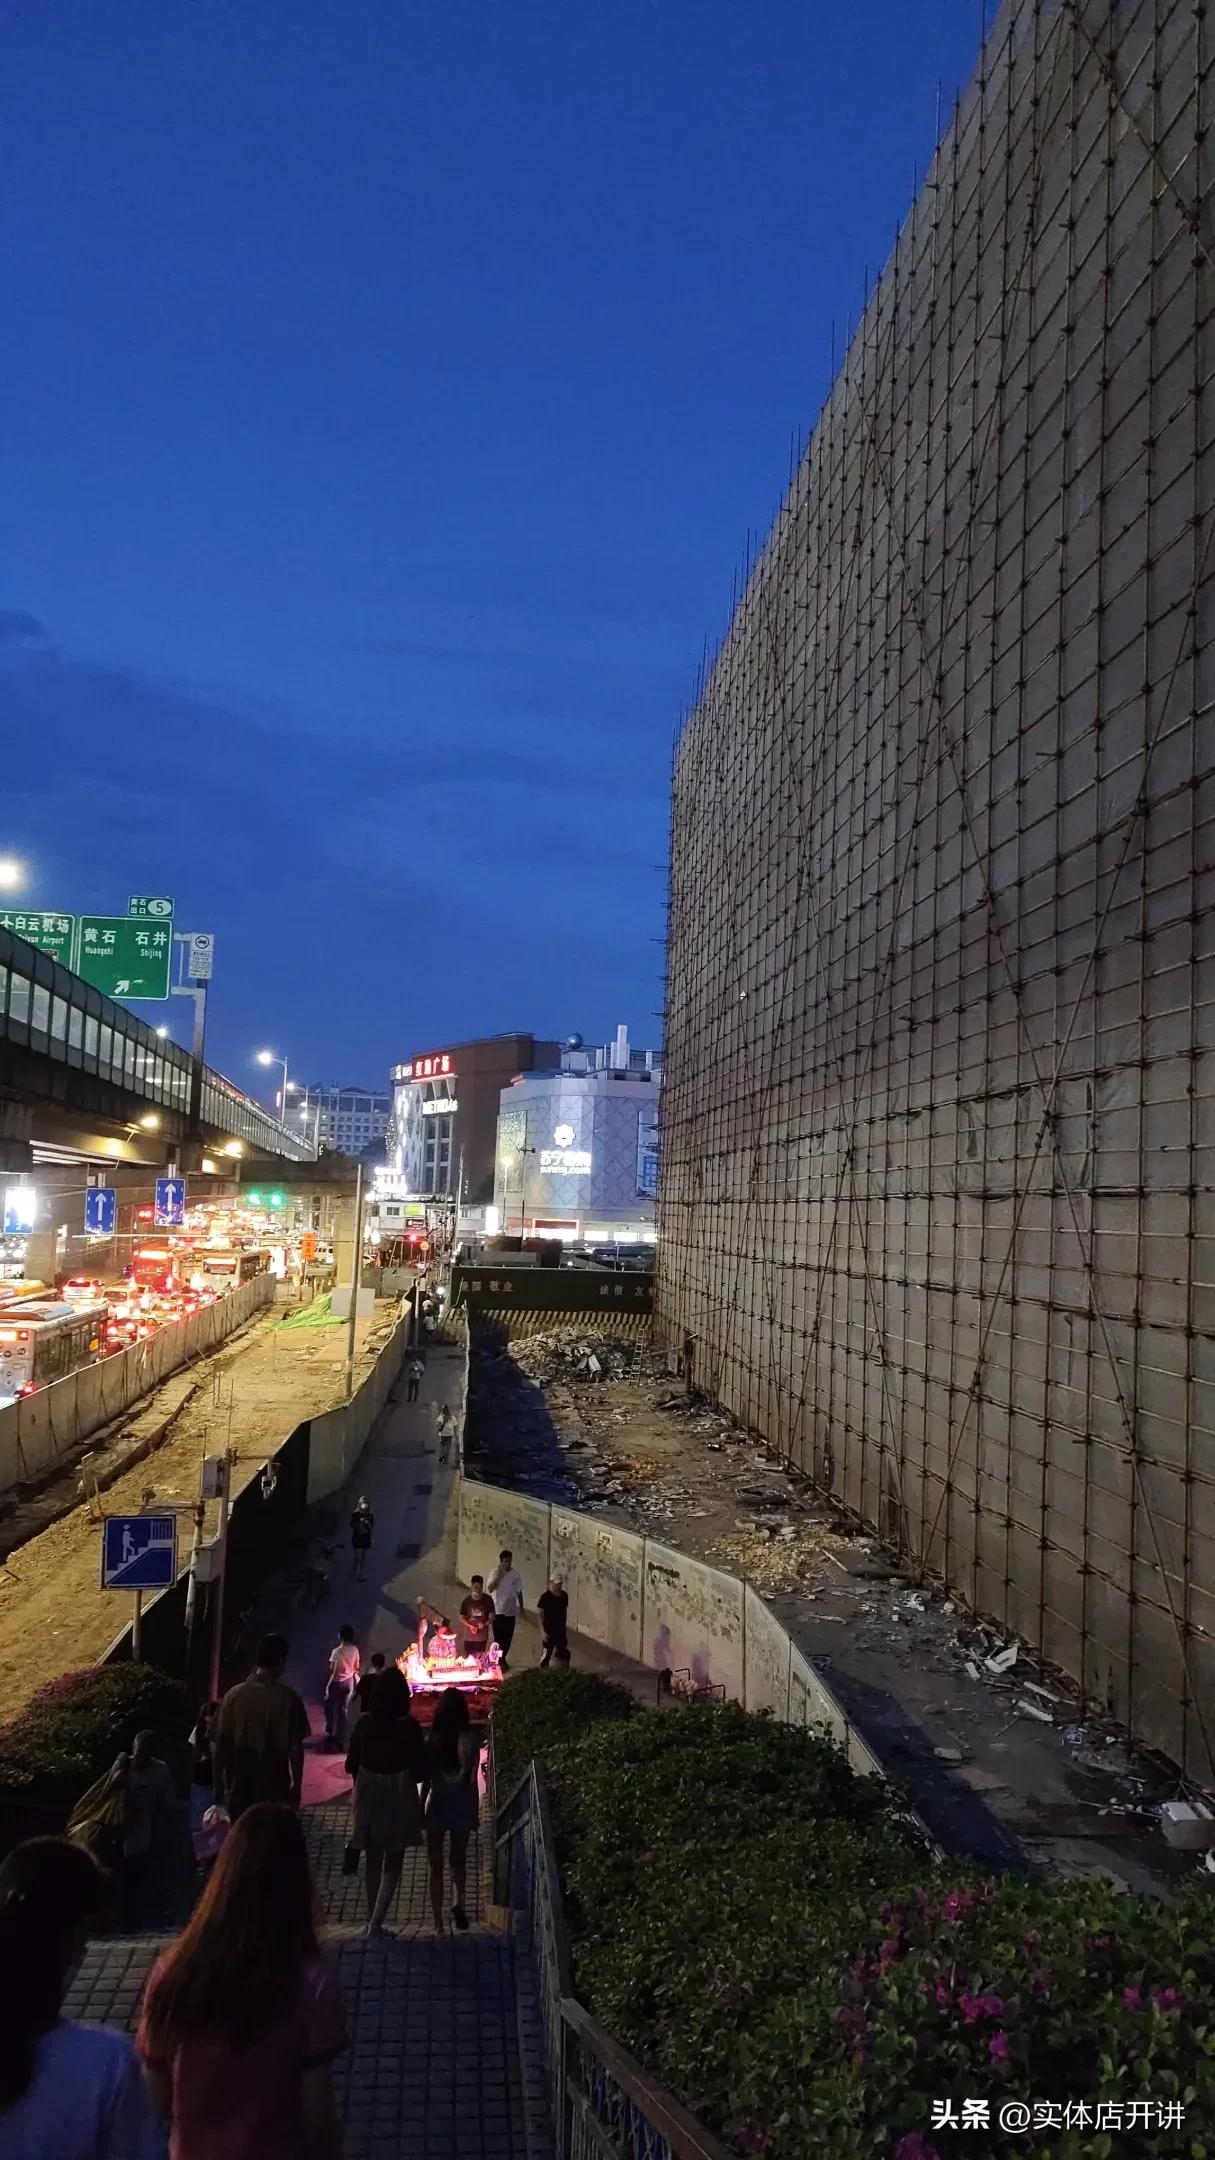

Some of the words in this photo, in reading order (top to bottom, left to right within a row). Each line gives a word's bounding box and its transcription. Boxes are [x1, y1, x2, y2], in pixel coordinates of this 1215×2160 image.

[130, 906, 146, 915] 出口
[156, 902, 164, 914] 5
[15, 915, 70, 934] 白云机场
[42, 935, 64, 946] Airport
[83, 927, 117, 944] 黄石
[135, 931, 168, 946] 石井
[85, 945, 114, 957] Huangshi
[140, 948, 162, 960] Shijing
